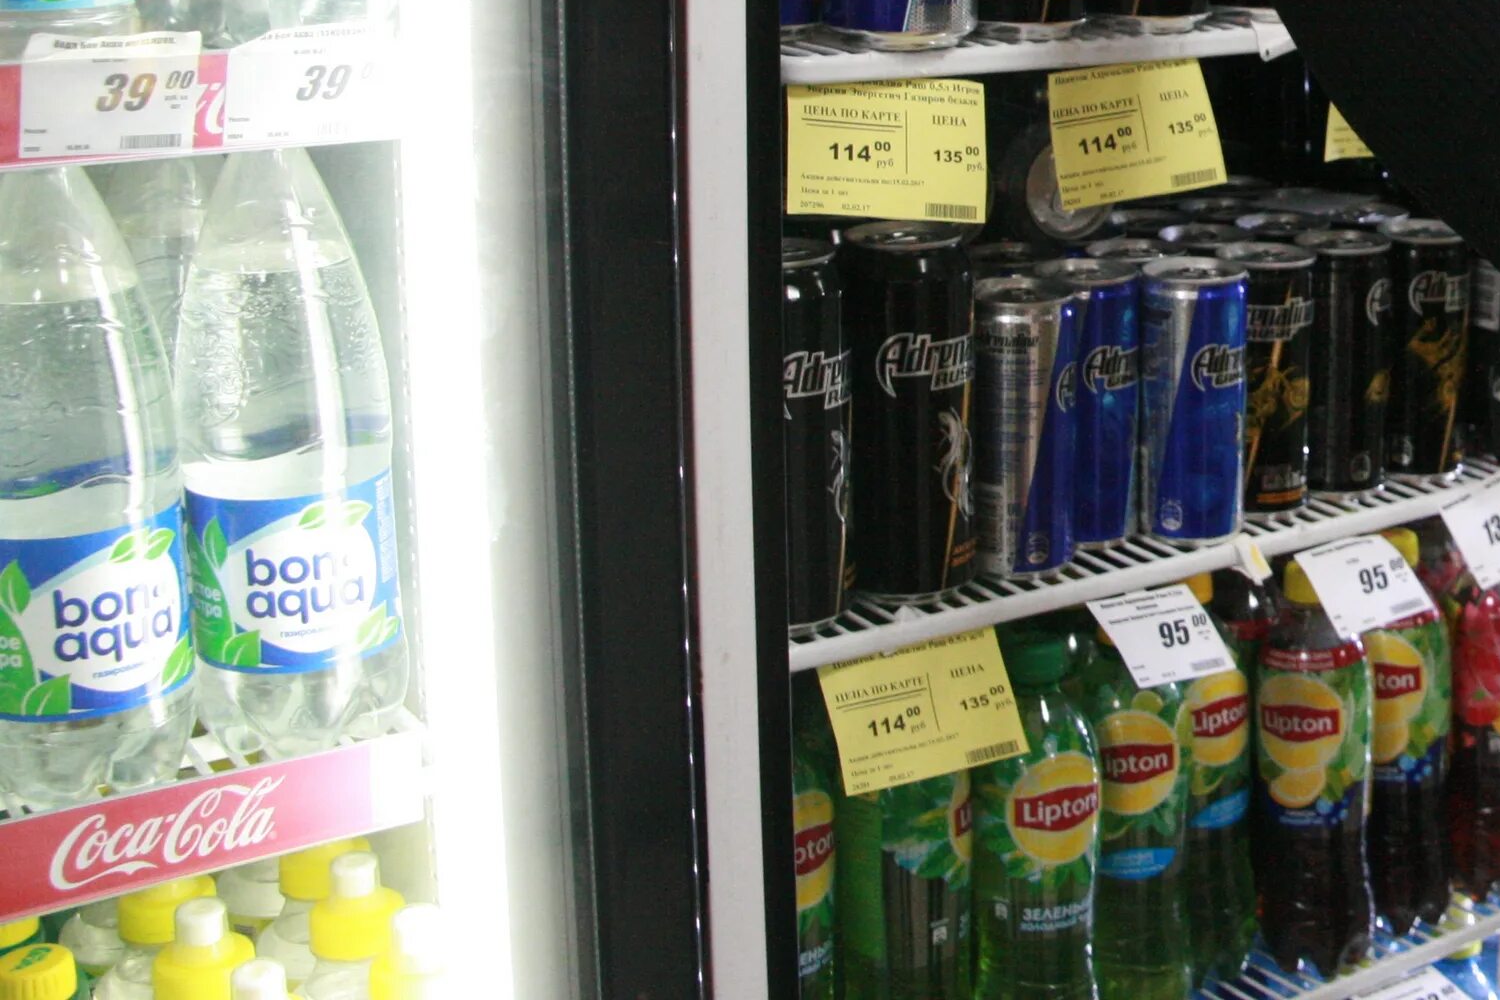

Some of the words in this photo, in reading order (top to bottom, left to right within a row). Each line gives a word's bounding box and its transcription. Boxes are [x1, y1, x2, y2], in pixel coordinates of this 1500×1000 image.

[95, 73, 157, 112] 39
[165, 70, 195, 89] 00
[296, 64, 352, 101] 39
[1159, 89, 1189, 102] ЦЕНА
[803, 104, 837, 118] ЦЕНА
[841, 108, 859, 119] ПО
[861, 109, 900, 122] КАРТЕ
[932, 114, 967, 127] ЦЕНА
[1053, 107, 1079, 120] ЦЕНА
[1082, 105, 1098, 114] ПО
[1100, 98, 1134, 111] КАРТЕ
[1168, 120, 1194, 135] 135
[1194, 112, 1207, 123] 00
[829, 142, 871, 162] 114
[874, 141, 891, 152] 00
[1078, 134, 1117, 155] 114
[1117, 126, 1132, 138] 00
[876, 157, 894, 169] руб
[933, 150, 963, 163] 135
[965, 147, 980, 156] 00
[245, 548, 337, 586] bon
[1359, 564, 1389, 594] 95
[53, 584, 150, 629] bon
[246, 576, 364, 624] aqua
[54, 605, 172, 662] aqua
[1159, 619, 1190, 648] 95
[1192, 613, 1207, 627] 00
[950, 663, 985, 679] ЦЕНА
[1377, 672, 1415, 689] ton
[872, 684, 888, 695] ПО
[890, 676, 924, 691] КАРТЕ
[960, 694, 990, 711] 135
[989, 684, 1005, 696] 00
[868, 713, 906, 737] 114
[906, 705, 921, 717] 00
[1264, 712, 1333, 732] Lipton
[1106, 752, 1168, 778] ipton
[1022, 793, 1097, 826] Lipton
[50, 775, 286, 890] Coca-Cola
[795, 831, 834, 865] pton
